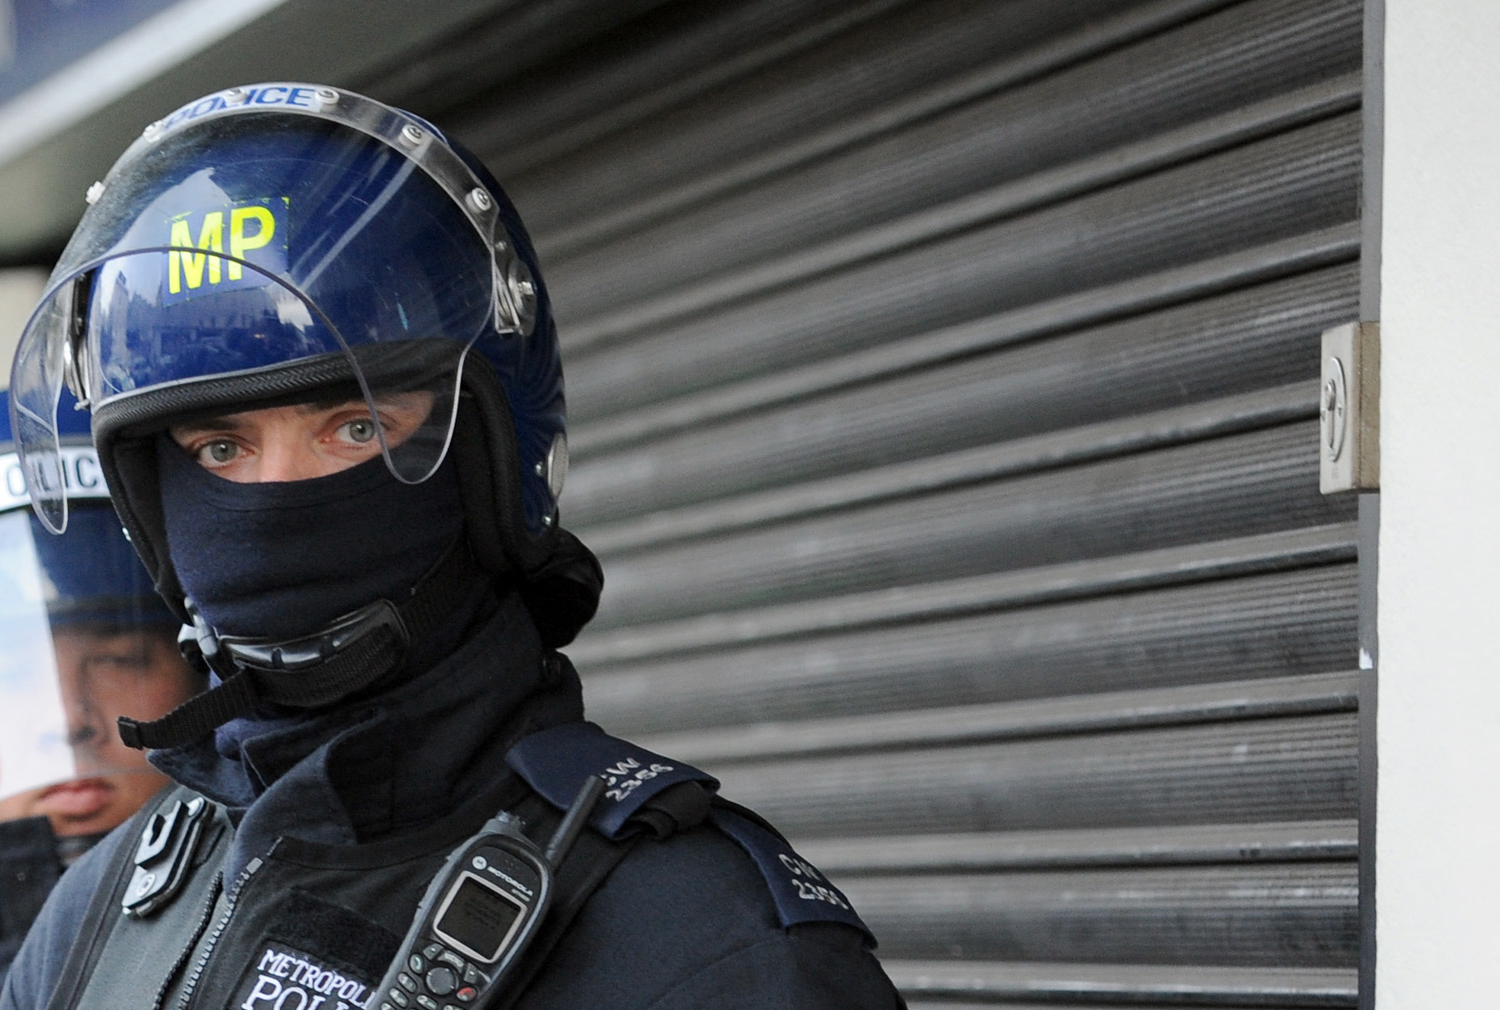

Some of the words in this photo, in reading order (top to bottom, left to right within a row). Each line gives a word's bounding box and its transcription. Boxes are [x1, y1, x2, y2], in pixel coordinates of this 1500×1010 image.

[164, 86, 316, 130] POLICE
[168, 204, 276, 295] MP
[487, 866, 534, 897] MOTOROLA
[257, 949, 377, 1010] METROPOLI
